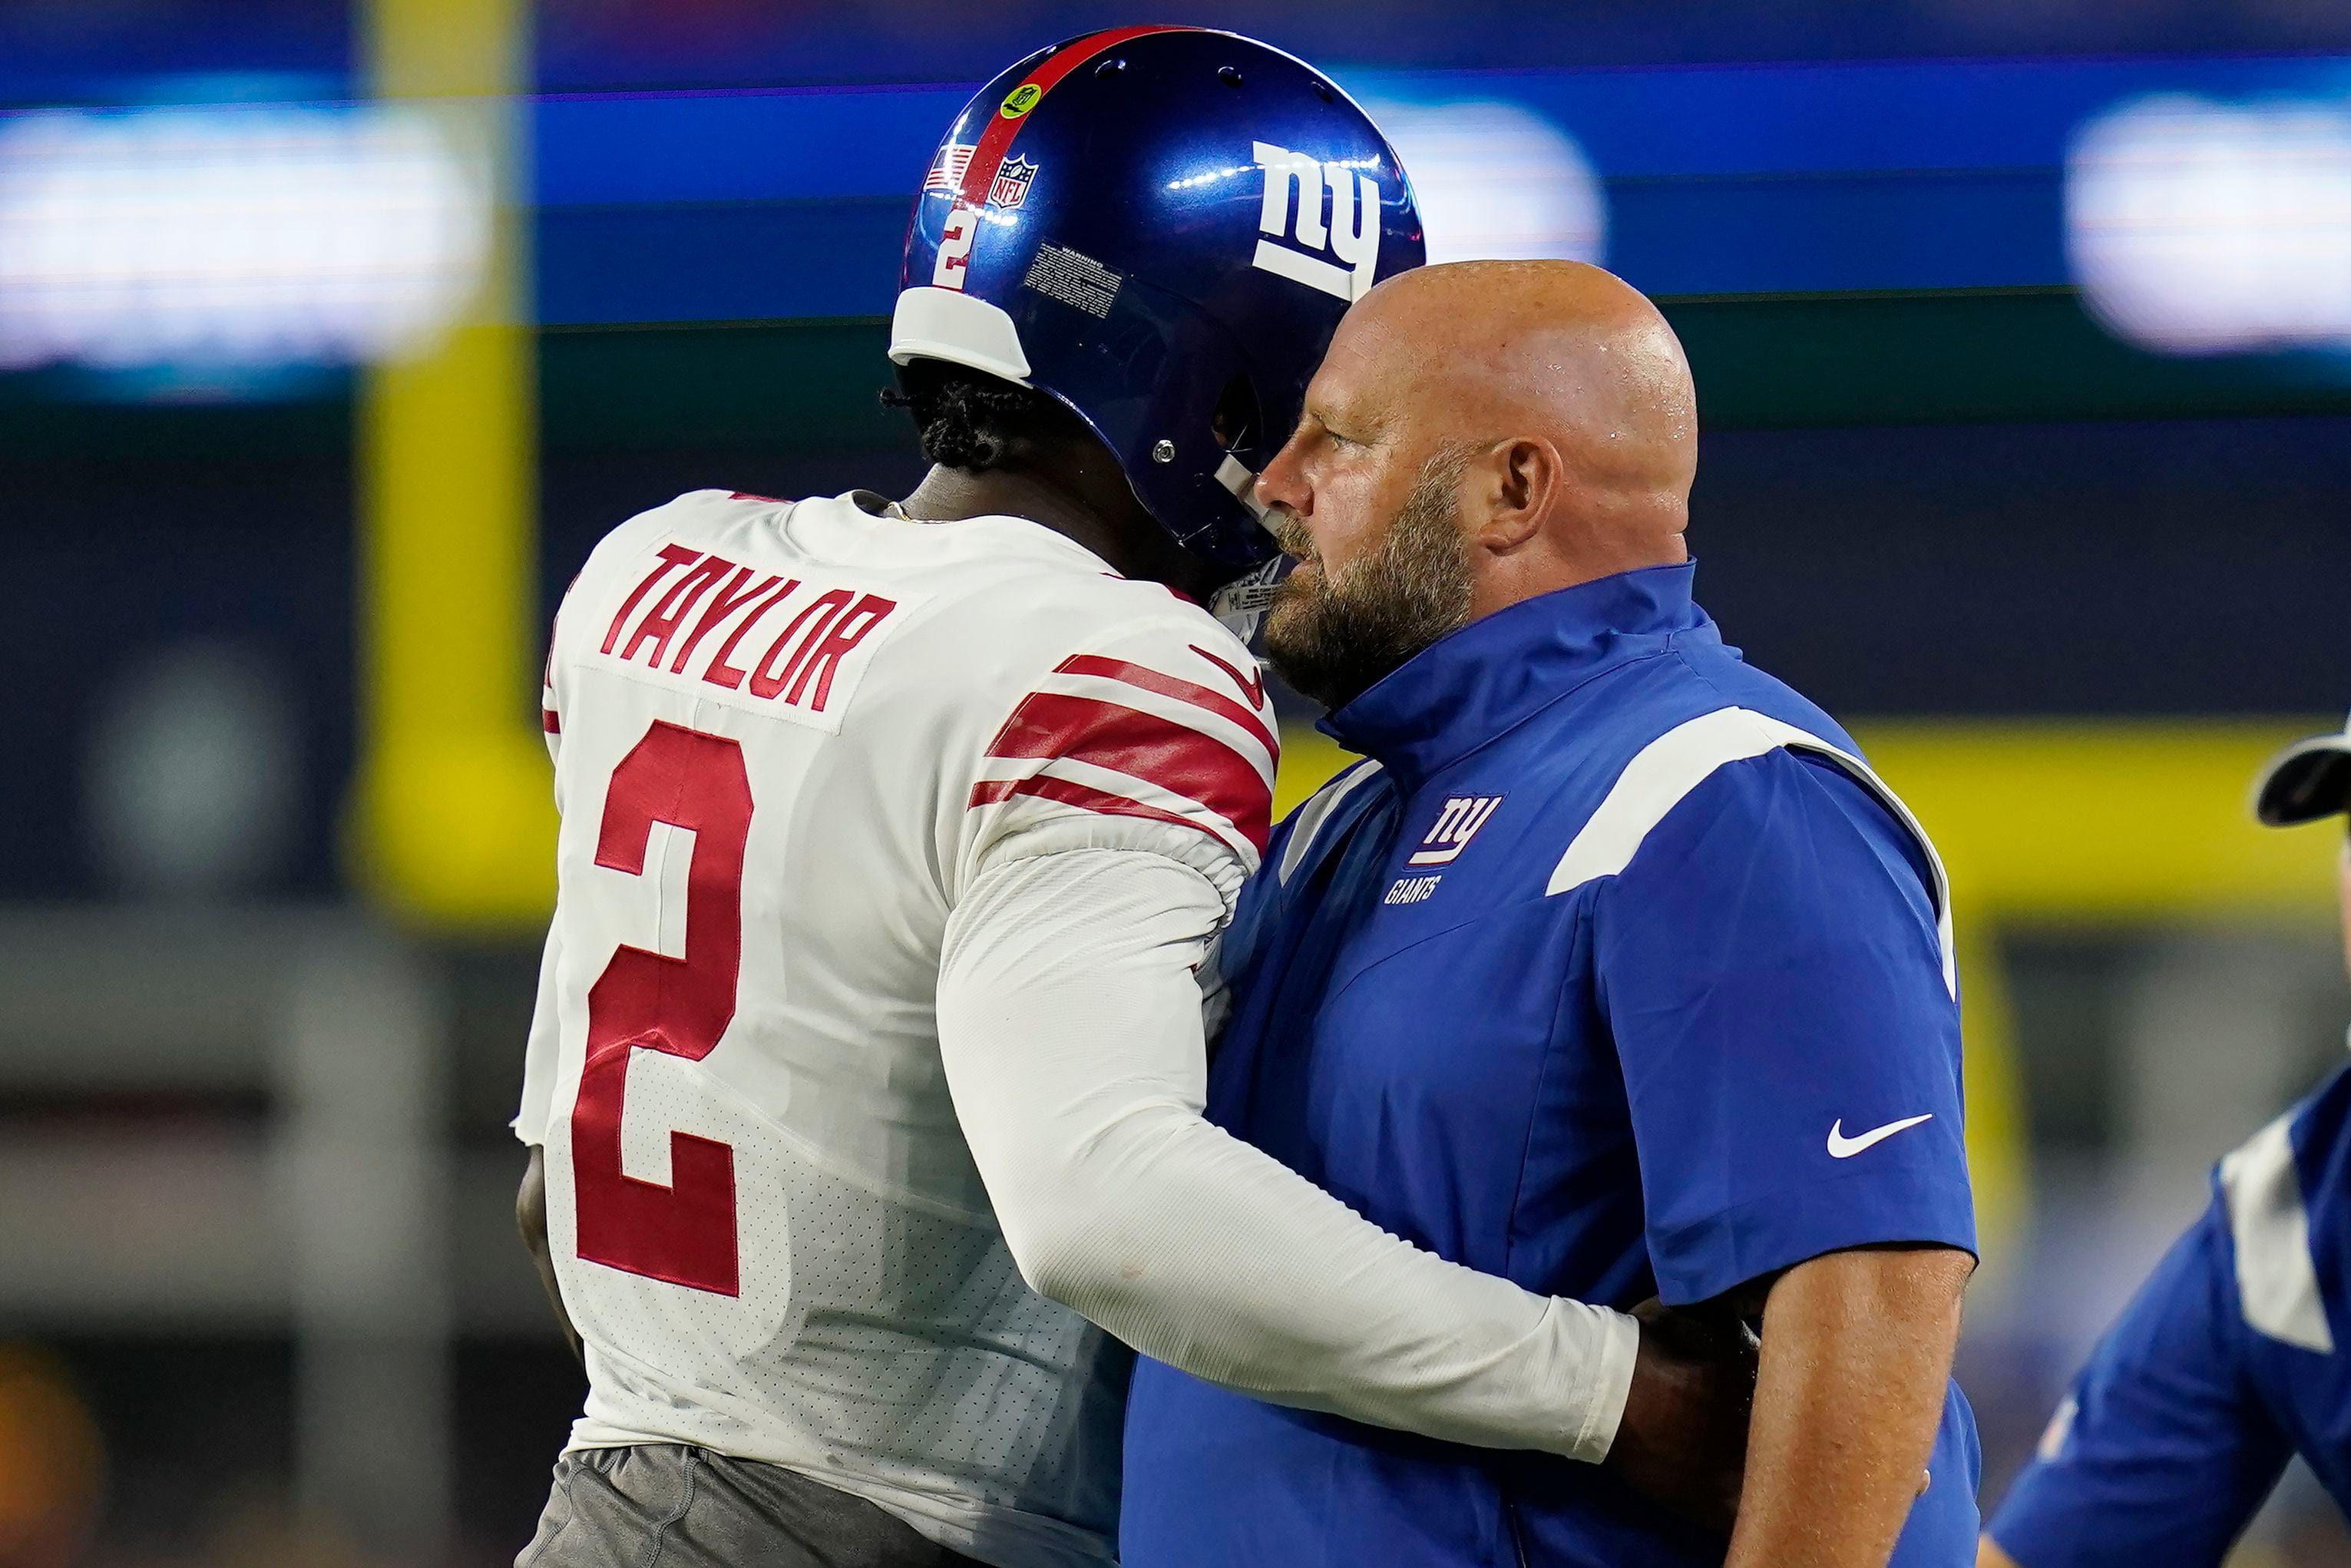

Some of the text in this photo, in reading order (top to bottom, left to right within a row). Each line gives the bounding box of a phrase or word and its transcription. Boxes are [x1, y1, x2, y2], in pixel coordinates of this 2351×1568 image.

[993, 178, 1022, 203] NFL
[932, 209, 977, 289] 2
[1062, 246, 1103, 268] WARNING
[600, 543, 896, 712] TAYLOR
[1384, 875, 1442, 905] GIANTS
[571, 719, 754, 1298] 2
